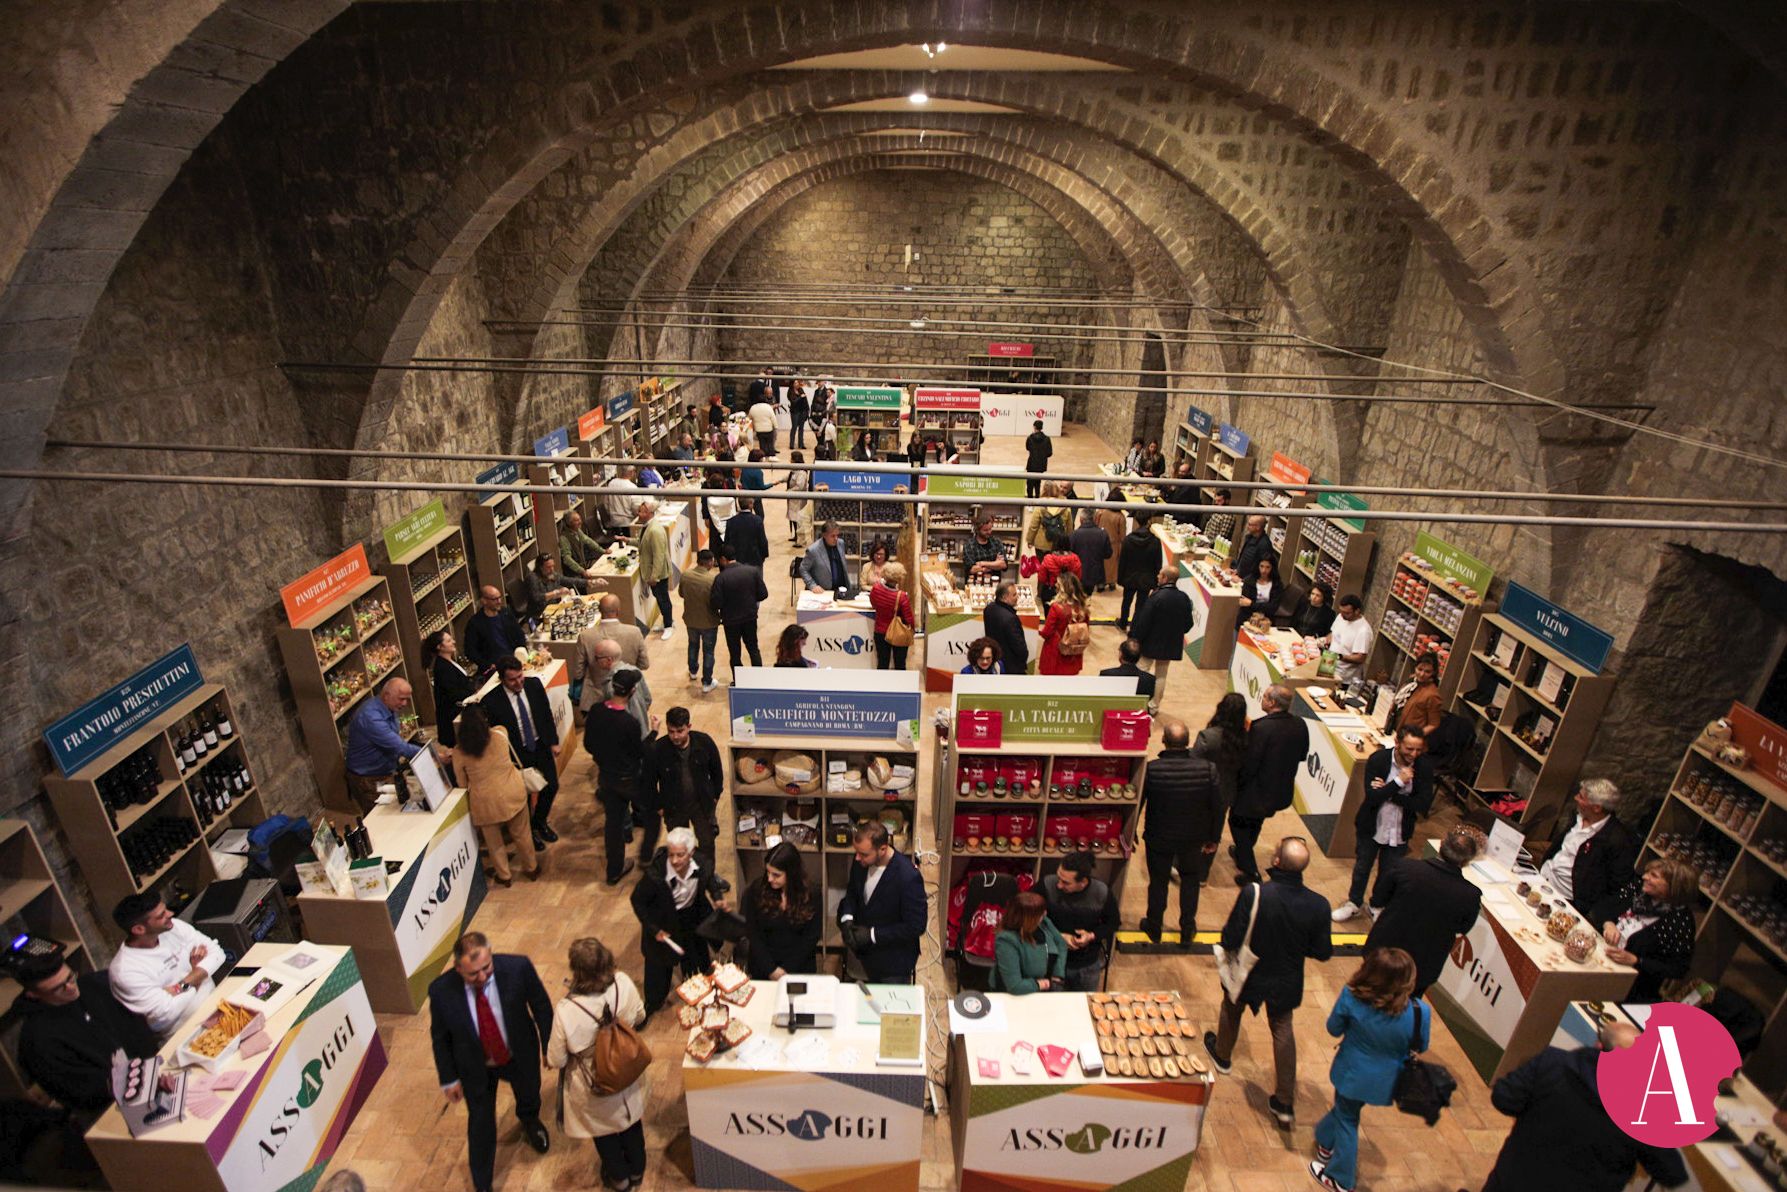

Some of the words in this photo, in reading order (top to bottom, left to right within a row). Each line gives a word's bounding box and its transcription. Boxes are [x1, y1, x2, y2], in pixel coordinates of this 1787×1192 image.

[1024, 409, 1057, 418] ASSAGGI
[843, 475, 862, 484] LAGO
[863, 476, 881, 485] VIVO
[1426, 545, 1444, 562] VIOLA
[295, 579, 327, 607] PANIFICIO
[327, 559, 360, 586] D'ABRUZZO
[1536, 609, 1569, 638] VULCINO
[813, 636, 874, 655] ASSAG
[63, 705, 122, 752] FRANTOIO
[121, 661, 191, 714] PRESCIUTTINI
[754, 708, 817, 721] CASEIFICIO
[820, 709, 897, 723] MONTETOZZO
[795, 702, 825, 710] AGRICOLA
[1008, 709, 1027, 723] LA
[1030, 709, 1095, 724] TAGLIATA
[784, 721, 824, 729] CAMPAGNANO
[833, 722, 851, 730] ROMA
[414, 840, 471, 941] ASSAGGI
[1450, 936, 1503, 1008] AGGI
[258, 1013, 357, 1174] ASSAGGI
[722, 1111, 889, 1141] ASSAGGI
[1000, 1125, 1168, 1152] ASSAGGI
